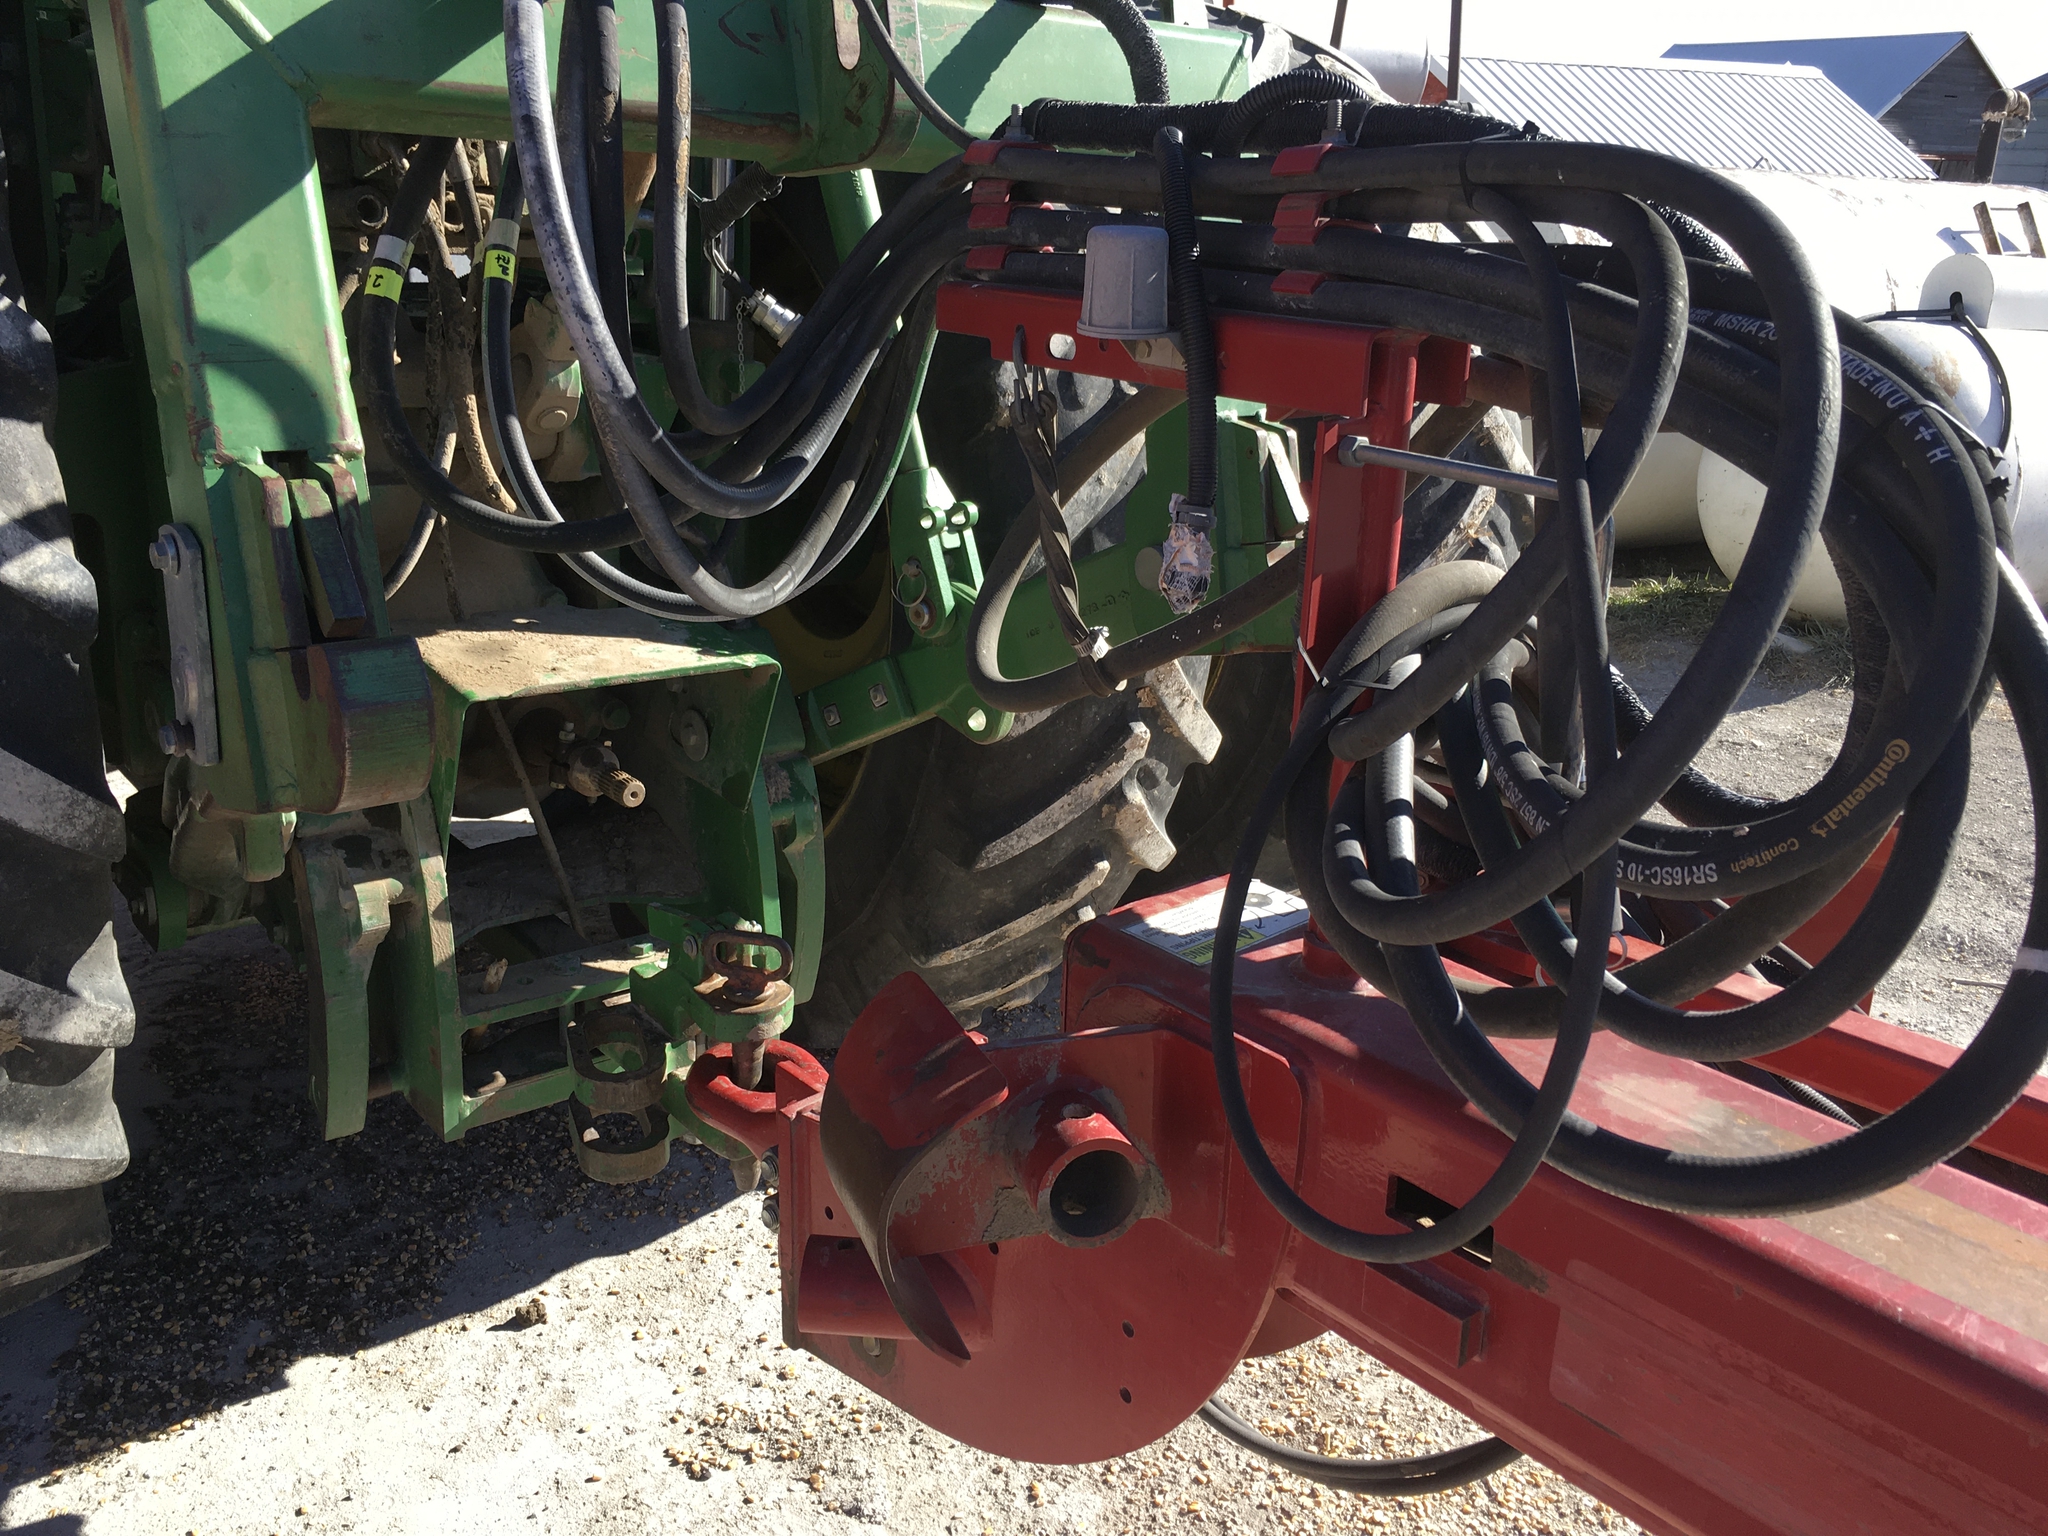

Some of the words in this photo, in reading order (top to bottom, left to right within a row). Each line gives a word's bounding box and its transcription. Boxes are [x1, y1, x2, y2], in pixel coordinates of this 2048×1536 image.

[1713, 313, 1762, 336] MSHA
[1869, 377, 1896, 400] IN
[1828, 738, 1911, 831] Continental
[1519, 801, 1538, 828] 857
[1730, 837, 1800, 874] ContiTech
[1626, 861, 1719, 886] SR16SC-10
